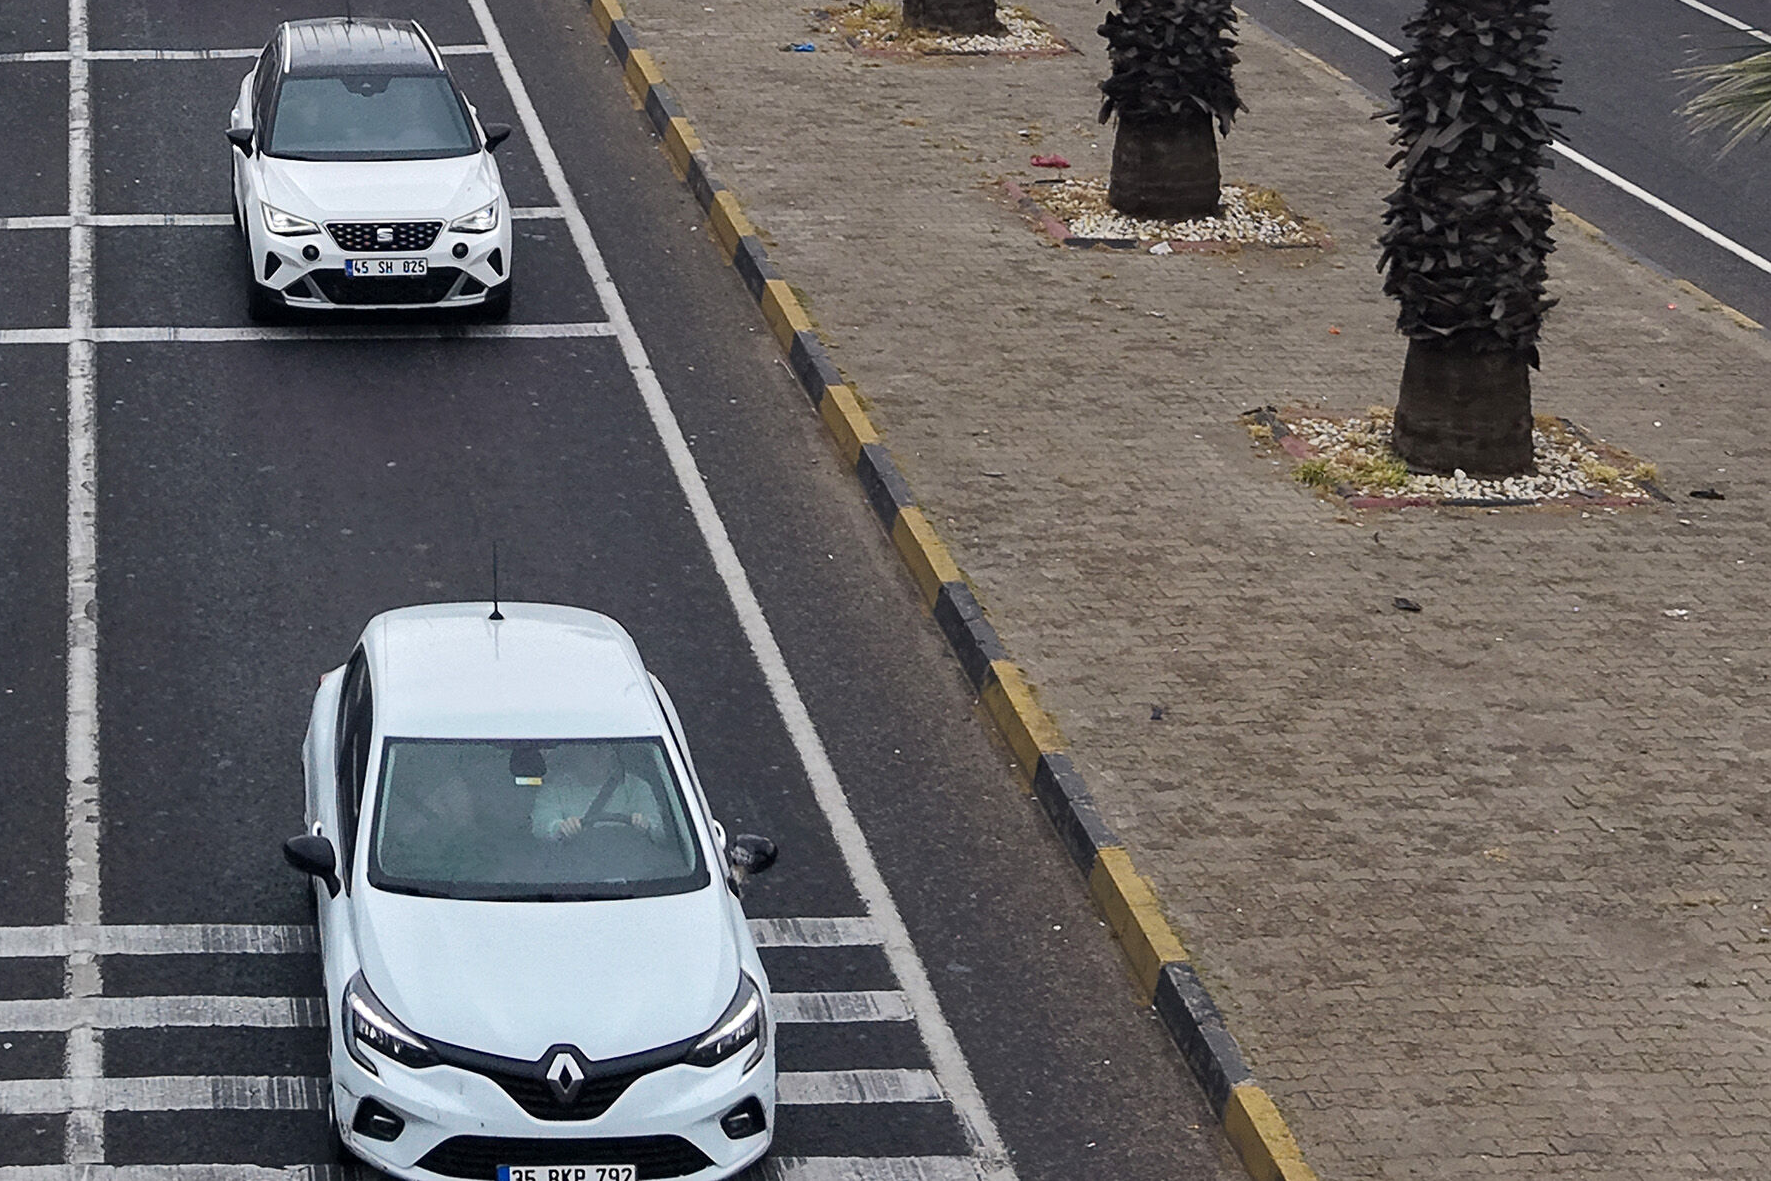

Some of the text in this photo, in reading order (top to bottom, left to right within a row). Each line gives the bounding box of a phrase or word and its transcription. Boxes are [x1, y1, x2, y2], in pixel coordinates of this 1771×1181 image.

[354, 260, 425, 274] 45 SH 025
[512, 1169, 536, 1181] 35
[596, 1167, 633, 1181] 792
